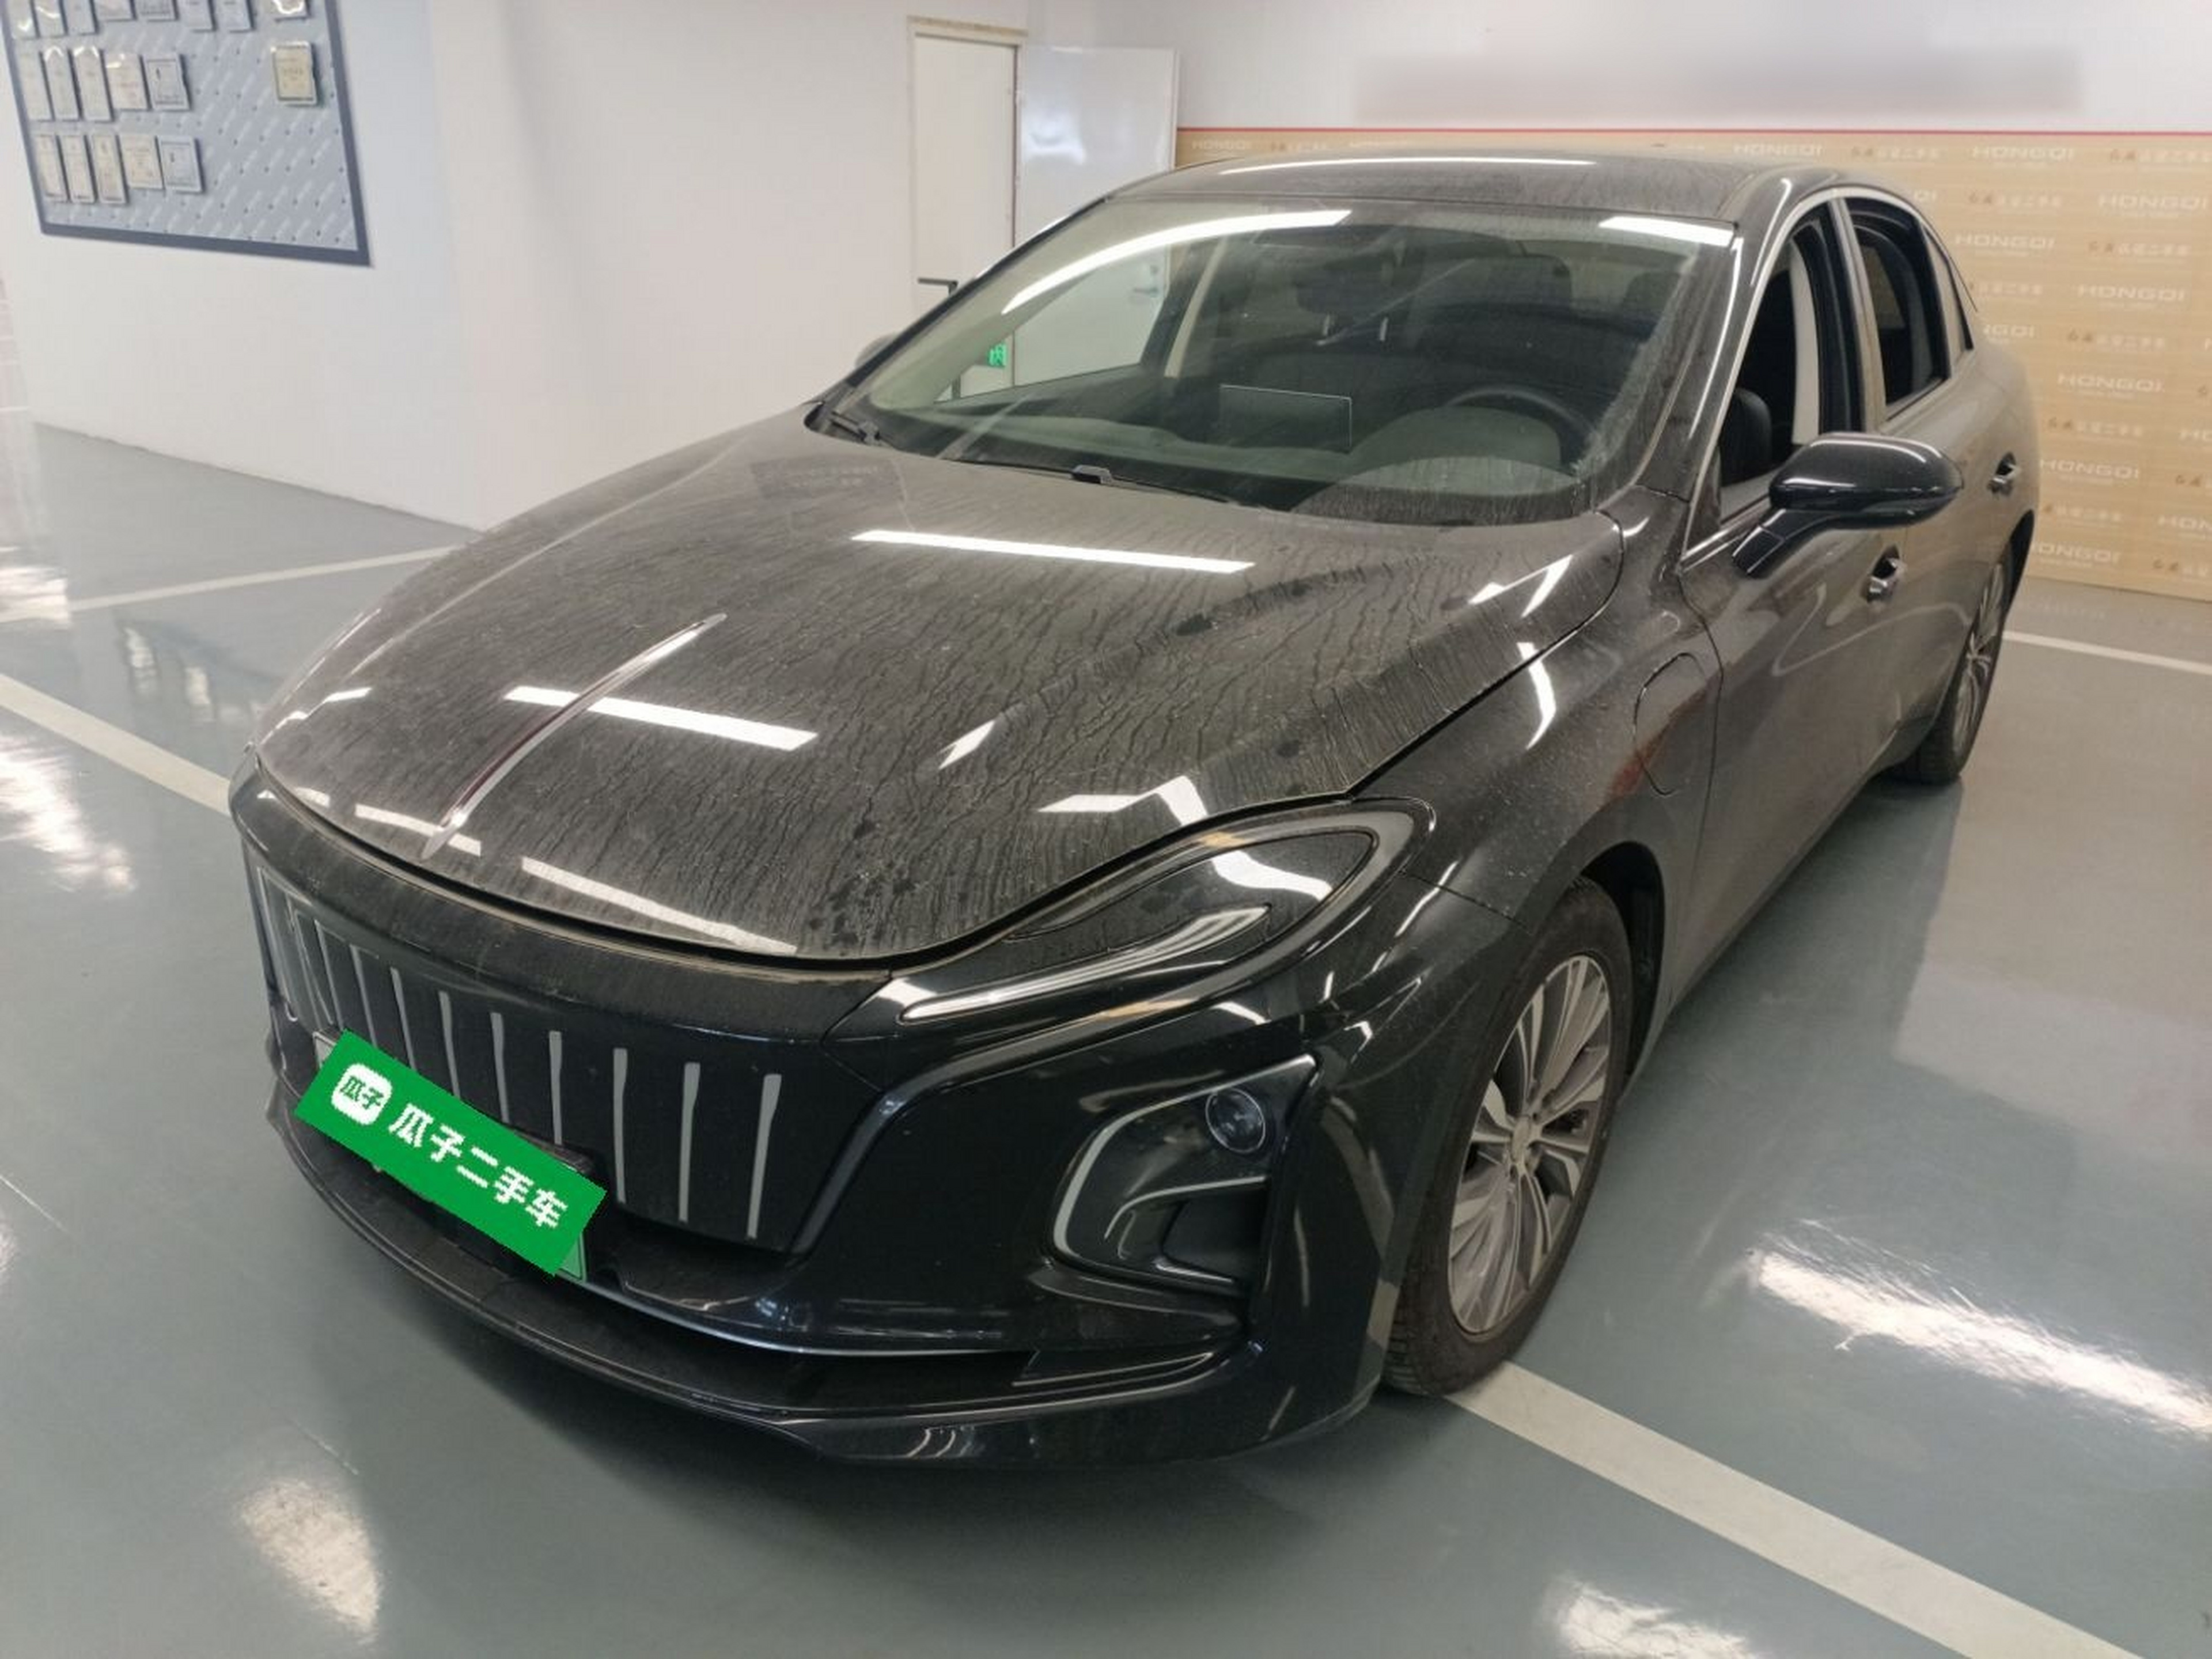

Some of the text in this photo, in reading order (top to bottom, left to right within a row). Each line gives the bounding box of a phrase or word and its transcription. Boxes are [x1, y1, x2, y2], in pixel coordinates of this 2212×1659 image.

[1972, 145, 2073, 161] HONGQI
[1956, 234, 2055, 249] HONGQI
[2077, 285, 2185, 302] HONGQI
[2058, 373, 2164, 392] HONGQI
